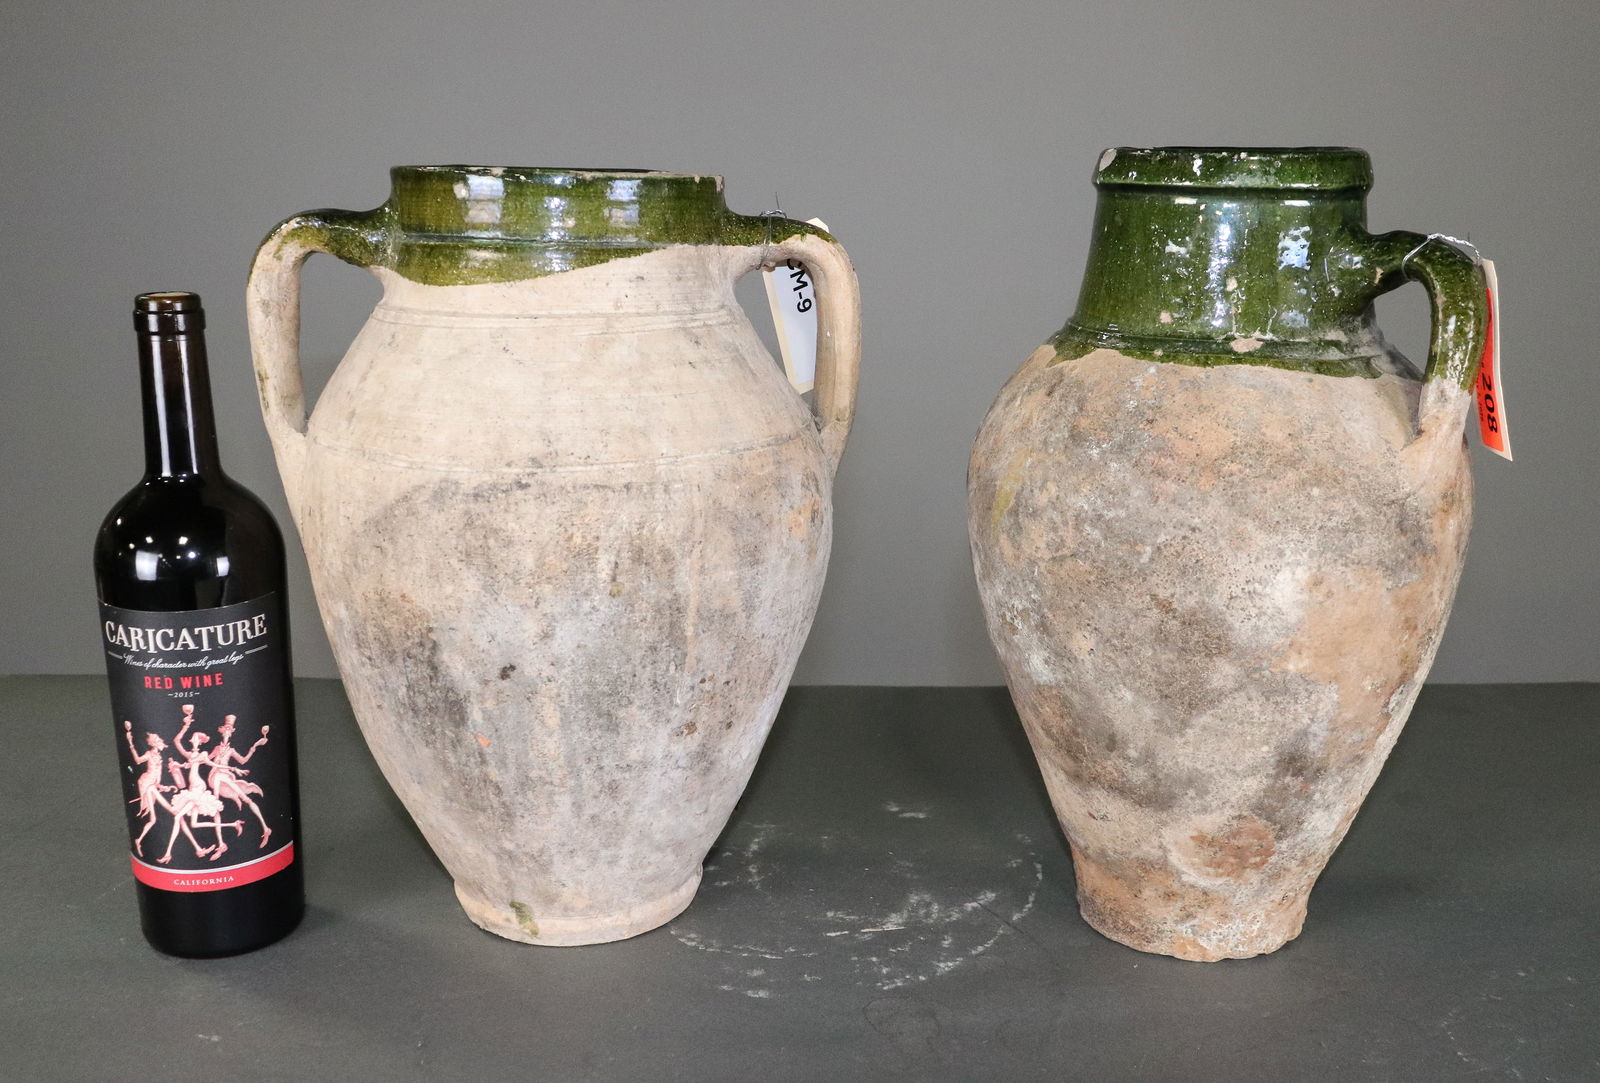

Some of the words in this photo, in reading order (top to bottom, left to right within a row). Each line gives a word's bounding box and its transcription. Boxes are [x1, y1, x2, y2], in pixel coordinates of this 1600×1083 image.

[1481, 372, 1498, 433] 208
[105, 614, 267, 653] CARICATURE
[123, 653, 143, 667] Wines
[143, 657, 155, 670] of
[152, 658, 188, 669] character
[187, 655, 206, 668] with
[205, 655, 229, 670] great
[228, 651, 244, 665] legs
[144, 676, 173, 689] RED
[180, 673, 224, 689] WINE
[174, 876, 234, 886] CALIFORNIA
